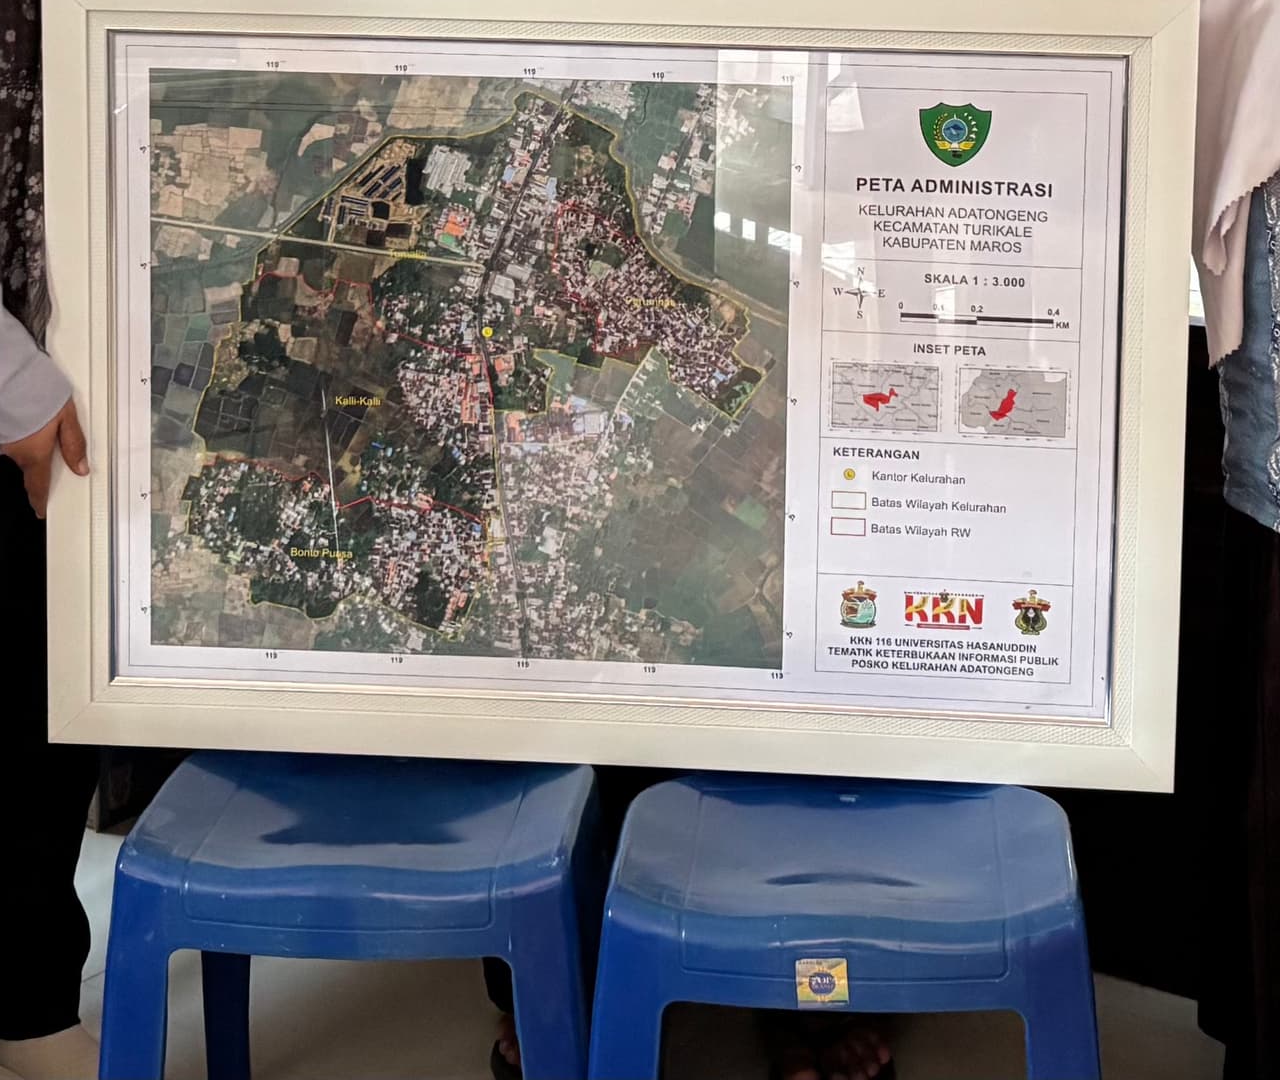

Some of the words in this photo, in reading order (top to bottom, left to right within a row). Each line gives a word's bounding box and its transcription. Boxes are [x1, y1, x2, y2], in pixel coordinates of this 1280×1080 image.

[856, 177, 905, 193] PETA
[911, 179, 1053, 198] ADMINISTRASI
[858, 204, 945, 219] KELURAHAN
[947, 207, 1048, 223] ADATONGENG
[873, 220, 959, 236] KECAMATAN
[964, 223, 1033, 238] TURIKALE
[882, 236, 966, 251] KABUPATEN
[970, 238, 1022, 253] MAROS
[857, 267, 865, 276] N
[924, 273, 969, 286] SKALA
[972, 275, 978, 286] 1
[992, 276, 1026, 288] 3.000
[833, 287, 844, 296] W
[877, 288, 886, 298] E
[898, 301, 904, 310] 0
[856, 310, 864, 320] S
[1055, 321, 1070, 329] KM
[913, 343, 949, 355] INSET
[954, 345, 986, 357] PETA
[832, 446, 920, 460] KETERANGAN
[871, 470, 907, 483] Kantor
[910, 472, 966, 486] Kelurahan
[871, 497, 902, 509] Batas
[905, 498, 949, 512] Wilayah
[952, 500, 1007, 514] Kelurahan
[871, 523, 902, 535] Batas
[905, 524, 948, 538] Wilayah
[951, 526, 971, 538] RW
[905, 594, 983, 625] KKN
[850, 636, 872, 646] KKN
[876, 637, 892, 647] 116
[895, 638, 964, 650] UNIVERSITAS
[967, 641, 1037, 653] HASANUDDIN
[828, 646, 873, 658] TEMATIK
[875, 649, 956, 661] KETERBUKAAN
[958, 652, 1017, 664] INFORMASI
[1020, 654, 1059, 666] PUBLIK
[851, 659, 889, 670] POSKO
[891, 661, 957, 673] KELURAHAN
[960, 664, 1034, 677] ADATONGENG
